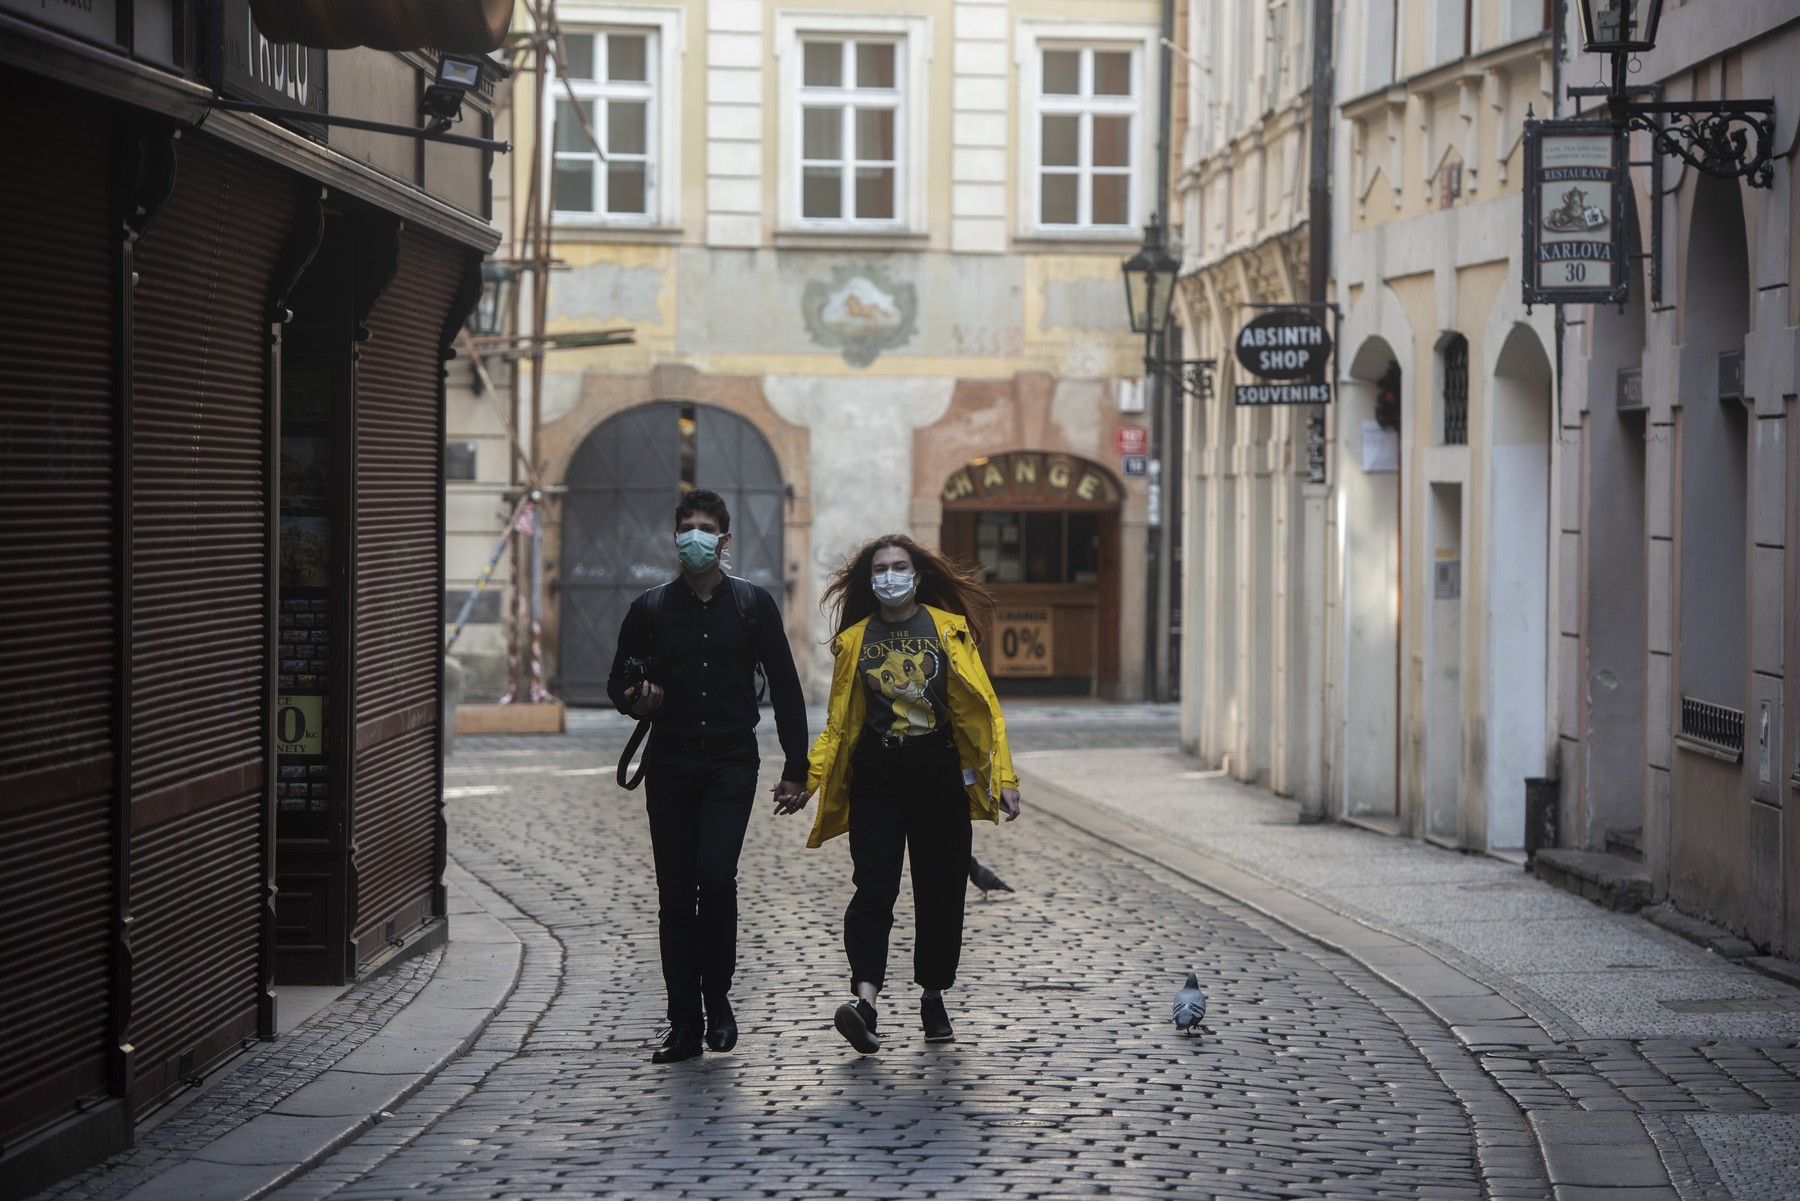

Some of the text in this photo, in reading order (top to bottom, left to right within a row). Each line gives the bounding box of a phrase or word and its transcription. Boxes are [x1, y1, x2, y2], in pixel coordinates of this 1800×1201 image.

[1544, 167, 1608, 180] RESTAURANT
[1540, 242, 1611, 260] KARLOVA
[1565, 263, 1586, 282] 30
[1241, 326, 1322, 347] ABSINTH
[1260, 349, 1310, 370] SHOP
[1237, 385, 1329, 403] SOUVENIRS
[943, 460, 1100, 501] CHANGE
[890, 630, 910, 638] THE
[1002, 626, 1046, 660] 0%
[859, 640, 894, 661] ION
[901, 638, 941, 654] KIN
